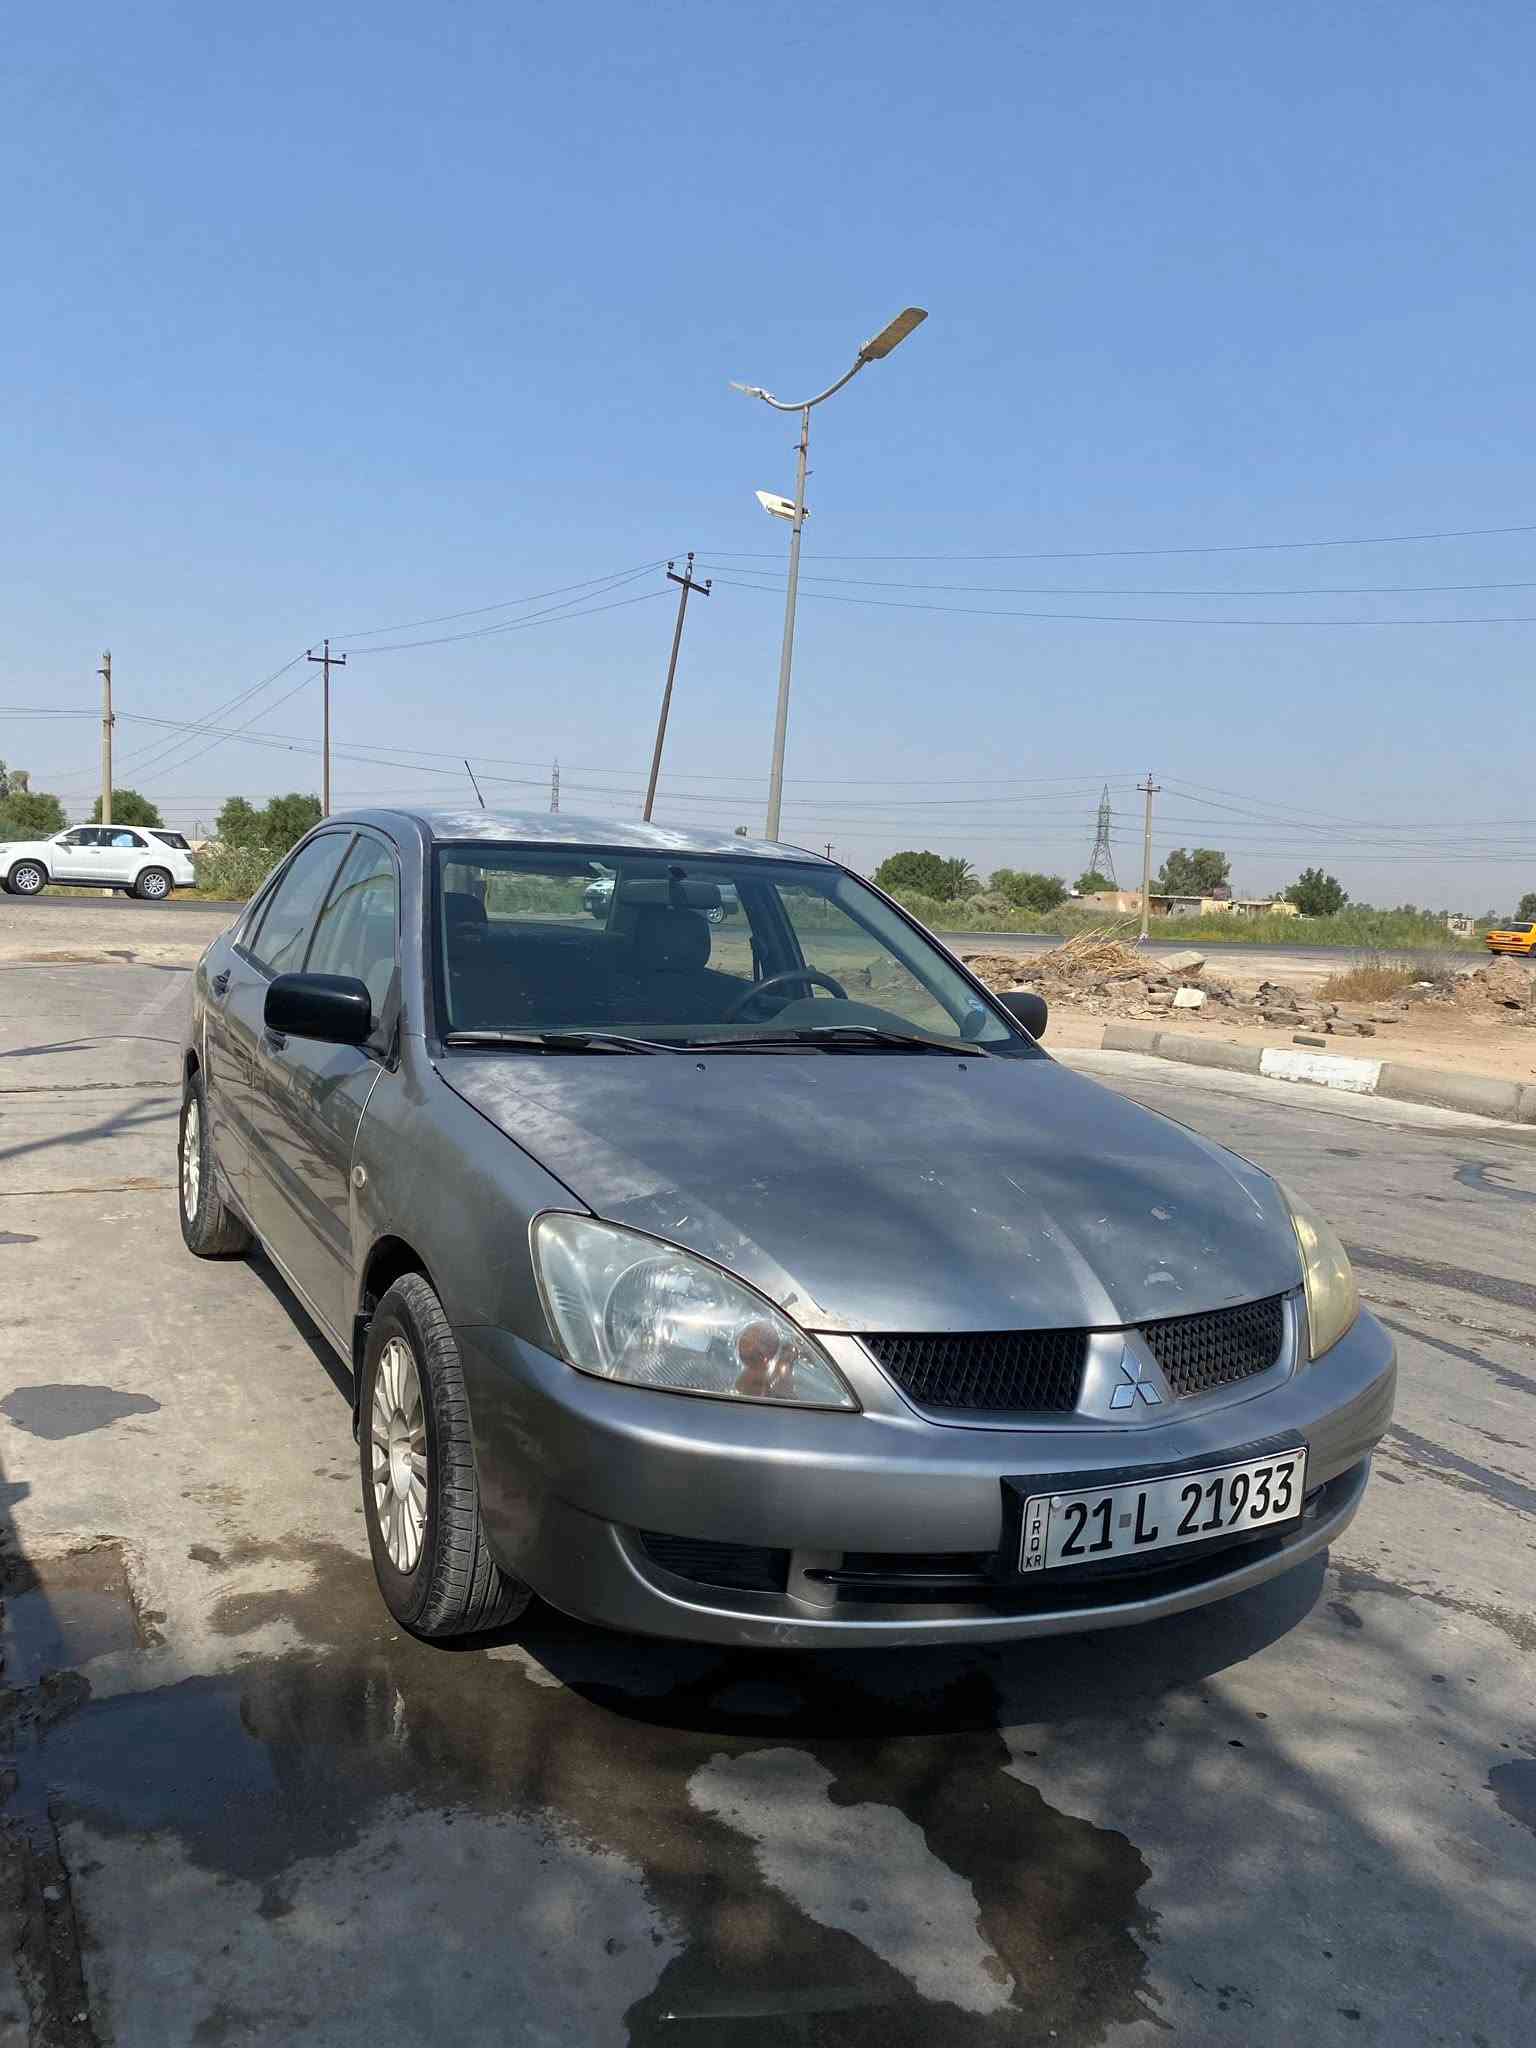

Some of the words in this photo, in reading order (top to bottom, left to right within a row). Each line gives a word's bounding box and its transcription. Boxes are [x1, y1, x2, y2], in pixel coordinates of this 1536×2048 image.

[1061, 1498, 1112, 1557] 21
[1134, 1492, 1158, 1544] L
[1177, 1462, 1294, 1536] 21933
[1026, 1554, 1041, 1568] KR
